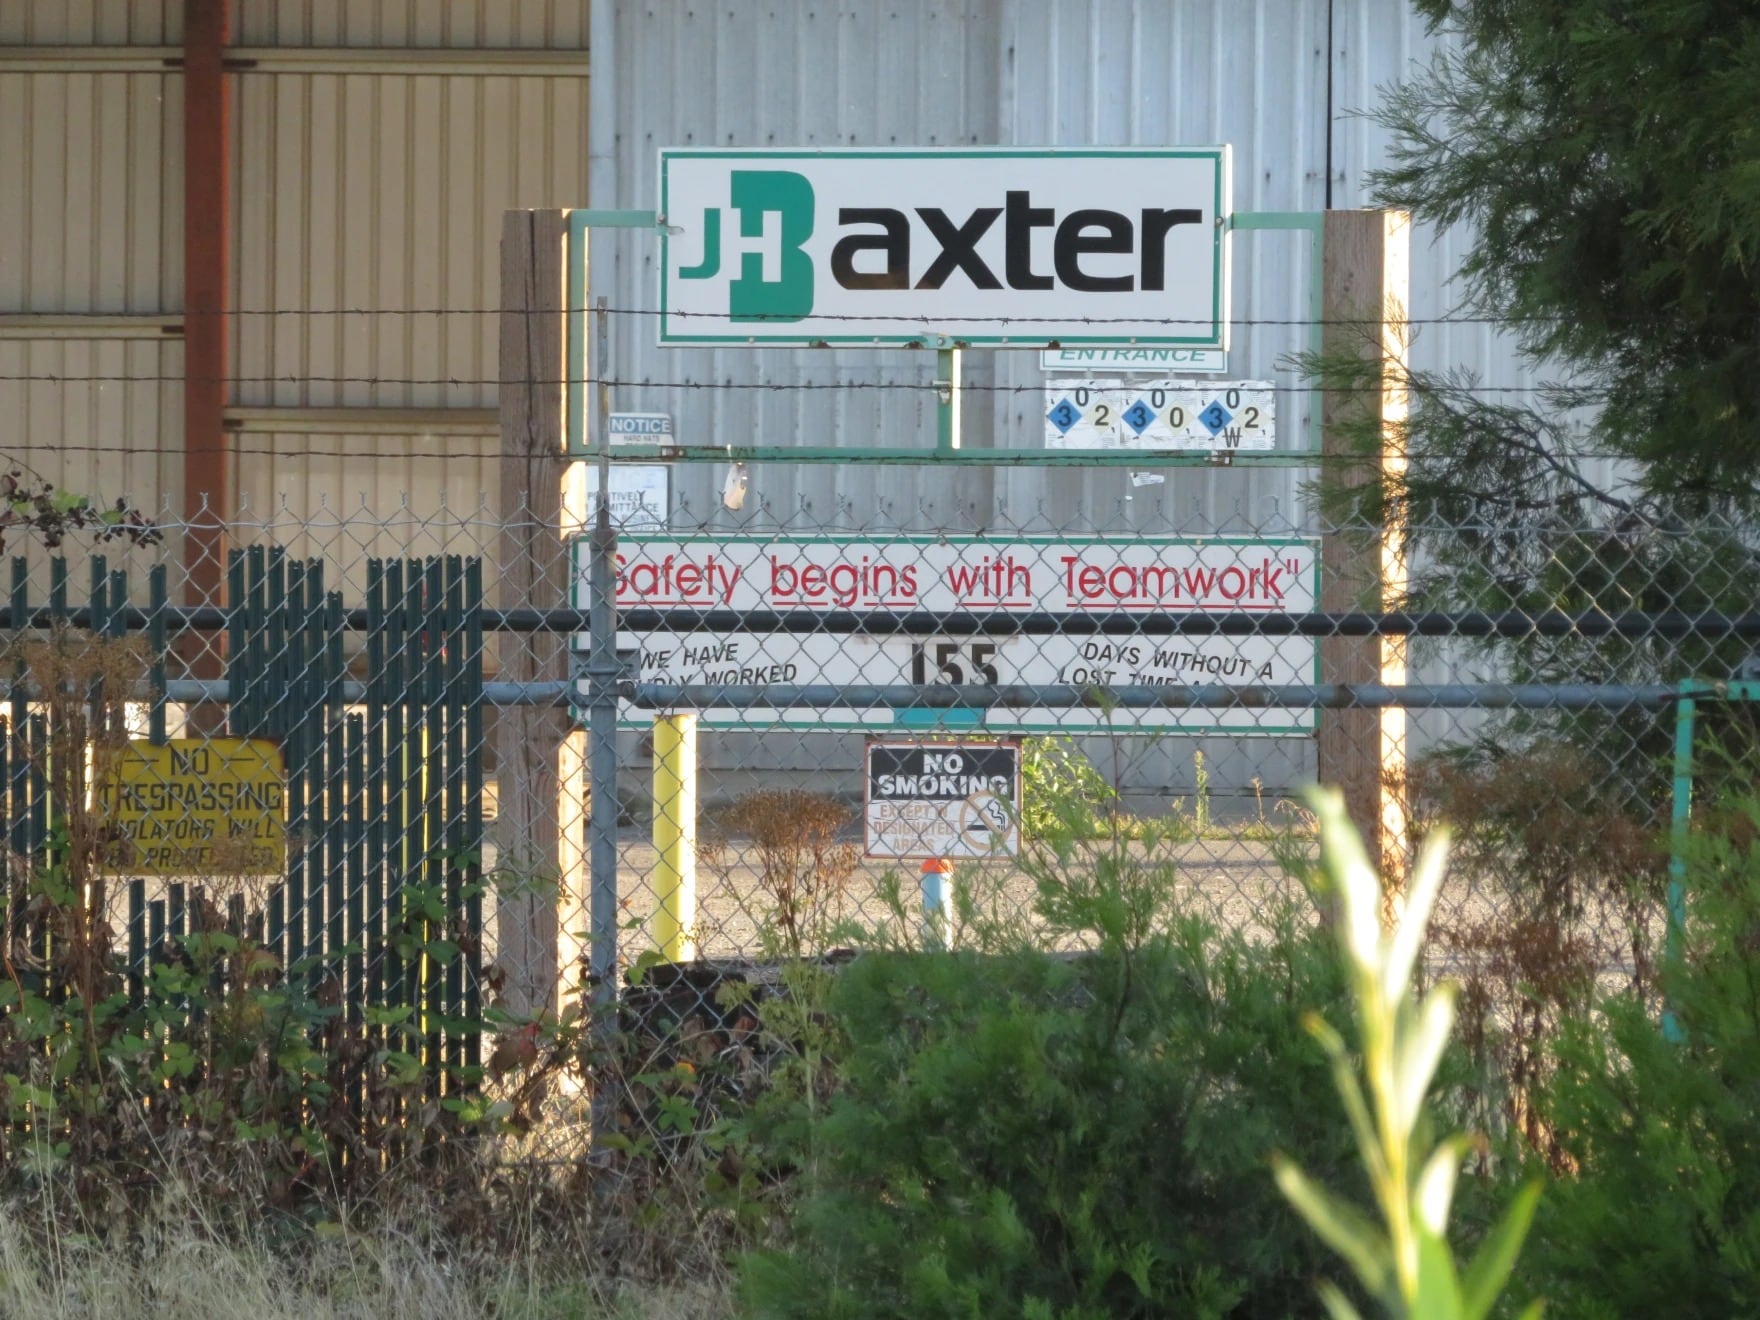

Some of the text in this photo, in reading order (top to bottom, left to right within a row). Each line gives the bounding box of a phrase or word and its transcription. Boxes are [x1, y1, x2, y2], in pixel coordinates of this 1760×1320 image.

[1060, 350, 1206, 362] ENTRANCE
[1075, 387, 1089, 407] 0
[1151, 389, 1165, 409] 0
[1226, 389, 1240, 409] 0
[611, 418, 671, 433] NOTICE
[1058, 405, 1072, 427] 3
[1094, 404, 1109, 426] 2
[1132, 406, 1146, 428] 3
[1169, 406, 1184, 428] 0
[1209, 407, 1223, 429] 3
[1244, 406, 1259, 428] 2
[615, 554, 1299, 608] Safety begins with Teamwork"
[640, 643, 739, 671] WE HAVE
[911, 643, 998, 686] 155
[1083, 642, 1274, 680] DAYS WITHOUT A
[705, 663, 797, 686] WORKED
[1058, 666, 1116, 686] LOST
[170, 748, 209, 776] NO
[923, 753, 964, 774] NO
[877, 774, 1009, 796] SMOKING
[101, 782, 281, 812] TRESPASSING
[880, 804, 930, 818] EXCEPT
[873, 821, 953, 836] DESIGNATED
[892, 838, 936, 851] AREAS
